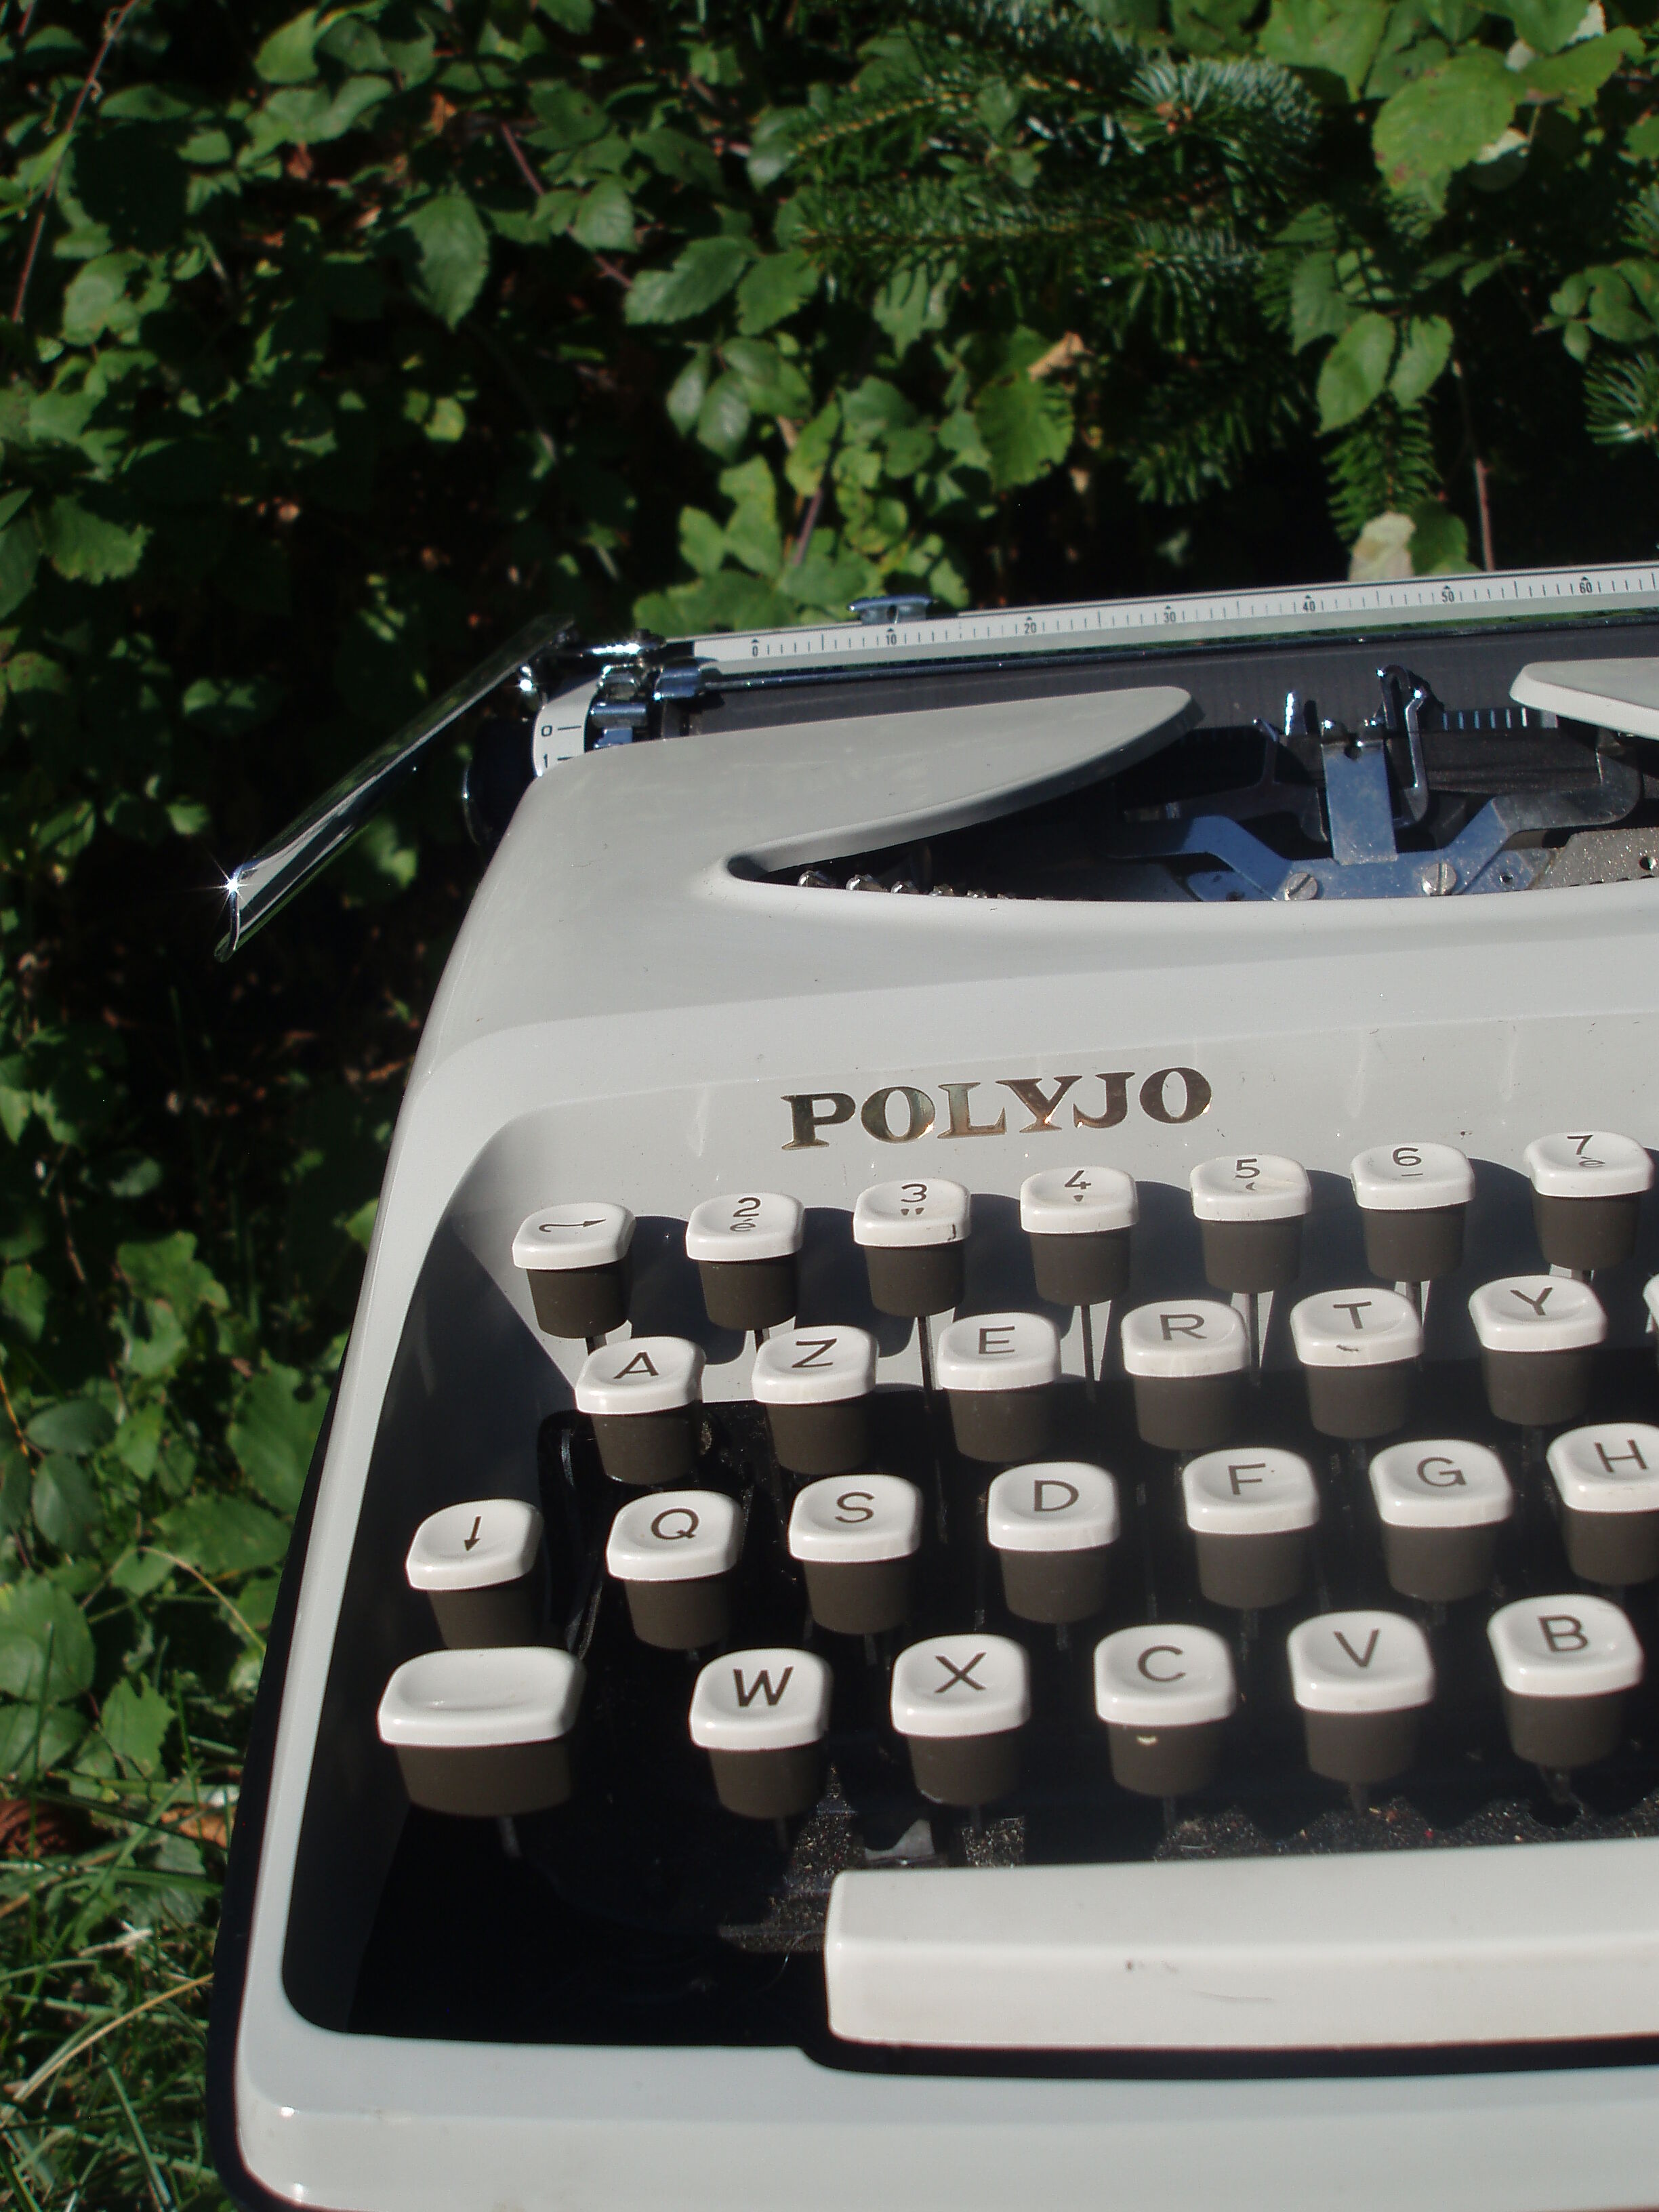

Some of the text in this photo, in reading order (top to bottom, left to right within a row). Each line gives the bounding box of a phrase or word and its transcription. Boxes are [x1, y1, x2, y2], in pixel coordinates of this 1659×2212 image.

[886, 633, 897, 645] 10
[1024, 621, 1037, 634] 20
[1164, 611, 1176, 624] 30
[1302, 600, 1316, 613] 40
[1441, 590, 1454, 603] 50
[1579, 580, 1592, 594] 60
[781, 1067, 1212, 1151] POLYJO
[1393, 1147, 1422, 1166] 6
[1567, 1134, 1594, 1155] 7
[1064, 1170, 1091, 1189] 4
[1235, 1158, 1260, 1179] 5
[733, 1197, 761, 1218] 2
[901, 1183, 927, 1202] 3
[1333, 1301, 1372, 1329] T
[1510, 1287, 1553, 1315] Y
[979, 1326, 1015, 1355] E
[1160, 1313, 1207, 1340] R
[613, 1351, 659, 1380] A
[792, 1338, 838, 1368] Z
[1416, 1456, 1467, 1487] G
[1594, 1439, 1647, 1473] H
[1228, 1462, 1266, 1495] F
[835, 1492, 874, 1523] S
[1033, 1479, 1079, 1512] D
[651, 1507, 699, 1540] Q
[1334, 1629, 1379, 1668] V
[1538, 1614, 1588, 1652] B
[934, 1652, 987, 1693] X
[1138, 1645, 1185, 1682] C
[733, 1666, 794, 1707] W
